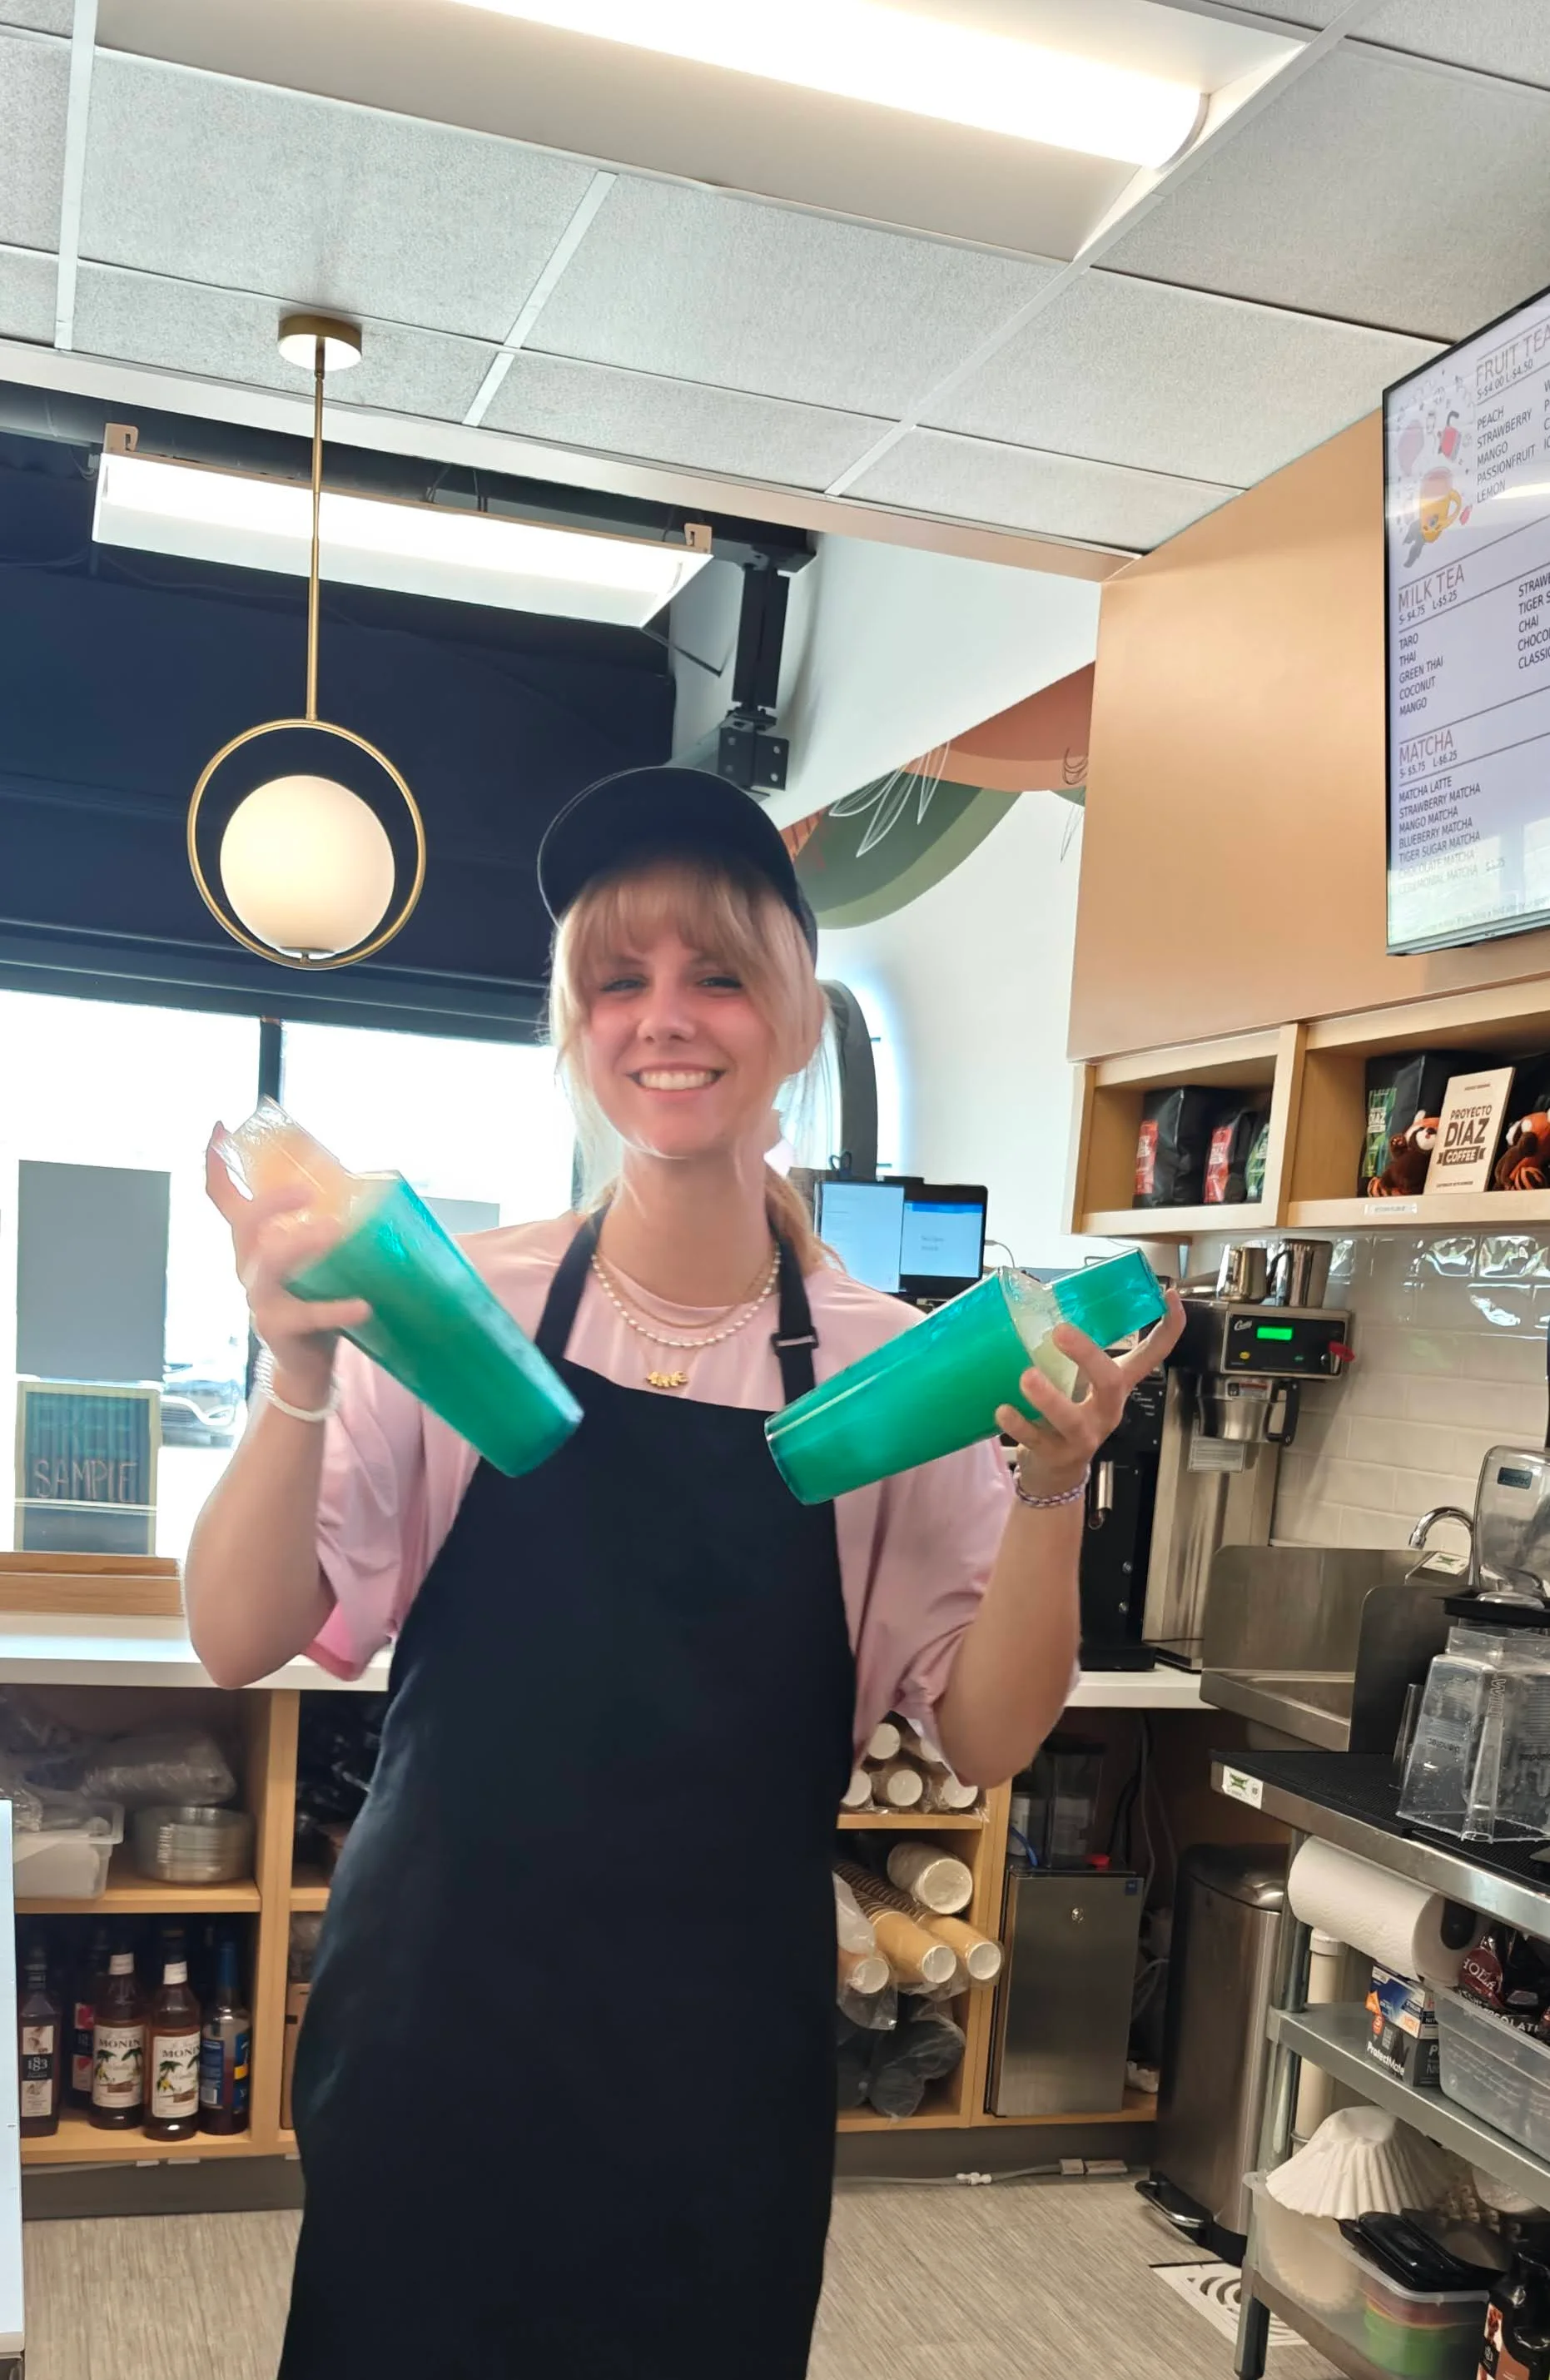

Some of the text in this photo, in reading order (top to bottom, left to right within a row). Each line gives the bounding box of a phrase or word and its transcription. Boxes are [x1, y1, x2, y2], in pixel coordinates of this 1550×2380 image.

[1476, 342, 1519, 386] FRUIT
[1477, 405, 1504, 430] PEACH
[1477, 408, 1532, 450] STRAWBERRY
[1477, 441, 1508, 468] MANGO
[1477, 444, 1536, 485] PASSIONFRUIT
[1477, 479, 1506, 504] LEMON
[1398, 564, 1464, 613] MILK TEA
[1518, 594, 1544, 615] TIGER
[1518, 614, 1539, 633] CHAI
[1398, 633, 1418, 650] TARO
[1398, 650, 1416, 667] THAI
[1398, 655, 1443, 683] GREEN THAI
[1399, 675, 1436, 700] COCONUT
[1399, 697, 1427, 716] MANGO
[1399, 729, 1453, 767] MATCHA
[1398, 776, 1453, 803] MATCHA LATTE
[1399, 782, 1481, 819] STRAWBERRY MATCHA
[1398, 805, 1458, 834] MANGO MATCHA
[1398, 816, 1473, 849] BLUEBERRY MATCHA
[1398, 831, 1480, 863] TIGER SUGAR MATCHA
[1450, 1105, 1493, 1120] PROYECTO
[1444, 1118, 1490, 1147] DIAZ
[1446, 1149, 1476, 1163] COFFEE
[33, 1459, 137, 1503] SAMPLE
[1366, 2040, 1405, 2076] ProtectMate
